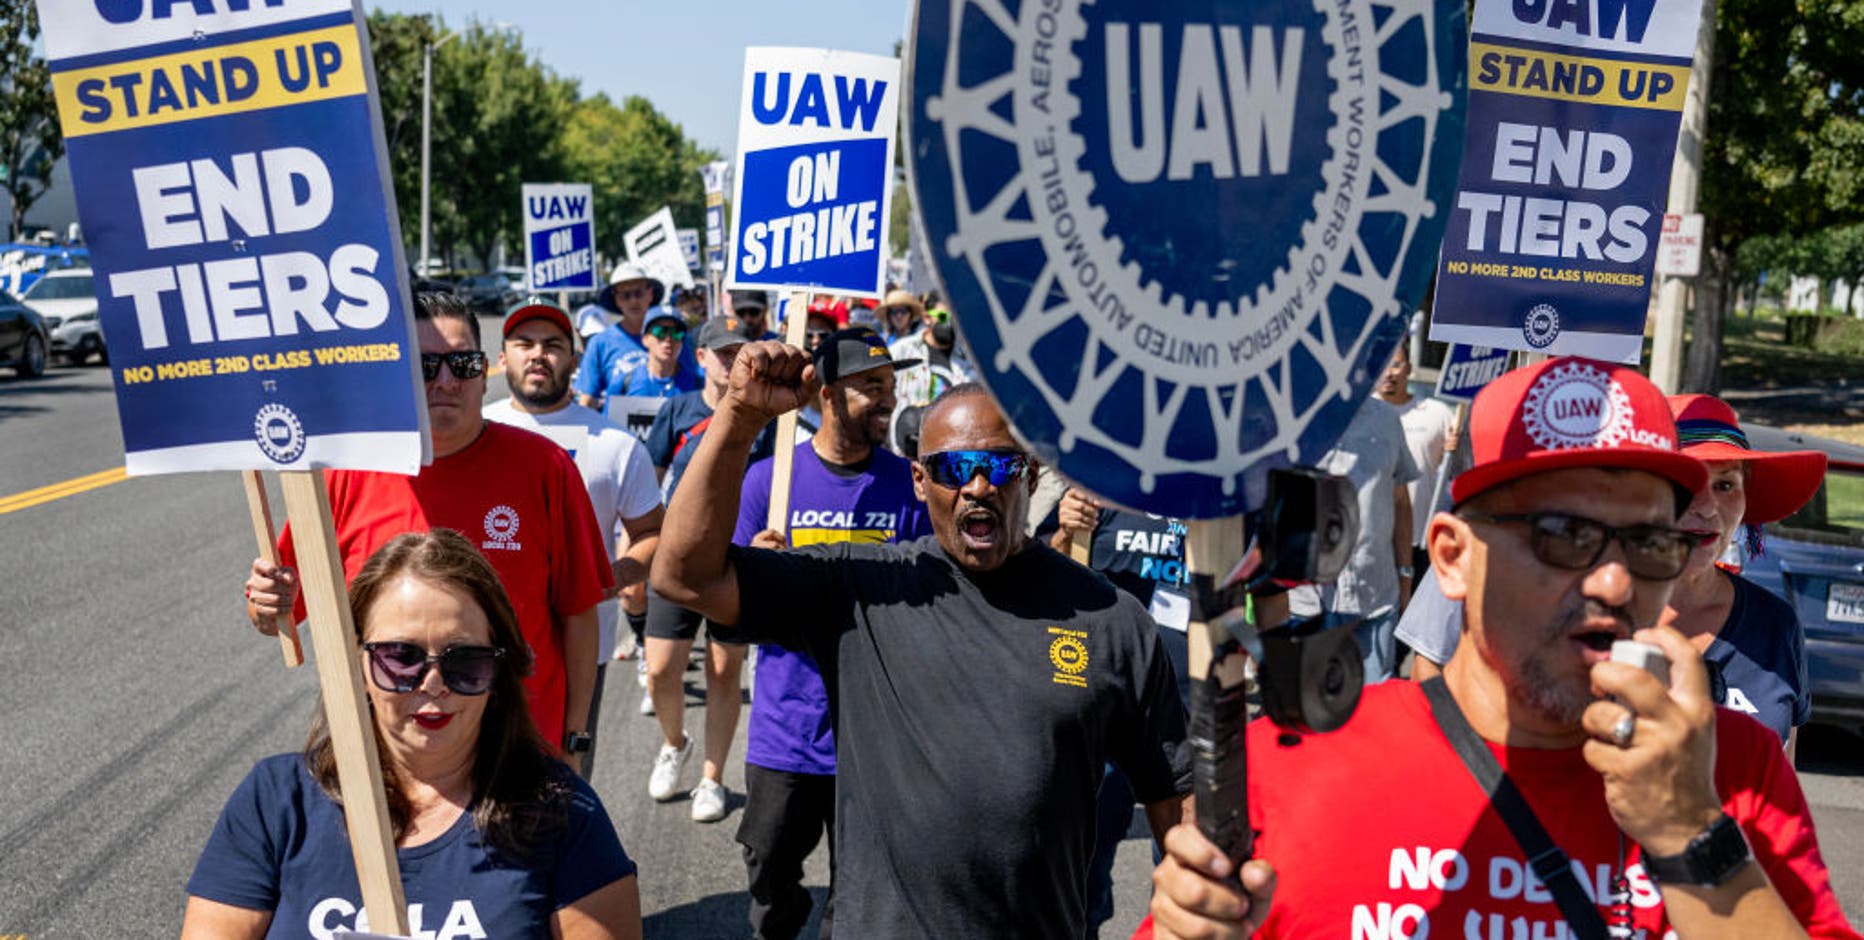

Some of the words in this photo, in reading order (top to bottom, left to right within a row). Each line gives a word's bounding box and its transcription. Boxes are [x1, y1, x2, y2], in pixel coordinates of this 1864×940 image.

[76, 56, 259, 124] STAND
[274, 41, 342, 93] UP
[1478, 52, 1605, 96] STAND
[1619, 69, 1674, 102] UP
[752, 72, 888, 132] UAW
[1105, 23, 1303, 183] UAW
[1323, 97, 1364, 251] WORKERS
[1492, 121, 1633, 190] END
[132, 147, 333, 250] END
[786, 150, 840, 208] ON
[529, 196, 586, 219] UAW
[1458, 191, 1651, 263] TIERS
[549, 227, 573, 256] ON
[742, 200, 876, 275] STRIKE
[534, 247, 590, 286] STRIKE
[1306, 253, 1326, 294] OF
[1447, 261, 1468, 274] NO
[1470, 263, 1509, 277] MORE
[1511, 265, 1537, 279] 2ND
[1539, 268, 1580, 282] CLASS
[1583, 271, 1645, 287] WORKERS
[109, 243, 390, 350] TIERS
[1134, 323, 1218, 368] UNITED
[1228, 287, 1304, 365] AMERICA
[123, 367, 154, 385] NO
[157, 360, 213, 380] MORE
[216, 357, 250, 375] 2ND
[252, 350, 312, 371] CLASS
[314, 343, 400, 365] WORKERS
[1445, 356, 1505, 391] STRIKE
[1553, 398, 1602, 421] UAW
[791, 509, 858, 528] LOCAL
[864, 511, 896, 529] 721
[1116, 530, 1180, 556] FAIR
[1140, 557, 1190, 584] NO
[1388, 846, 1470, 891] NO
[1351, 902, 1430, 940] NO
